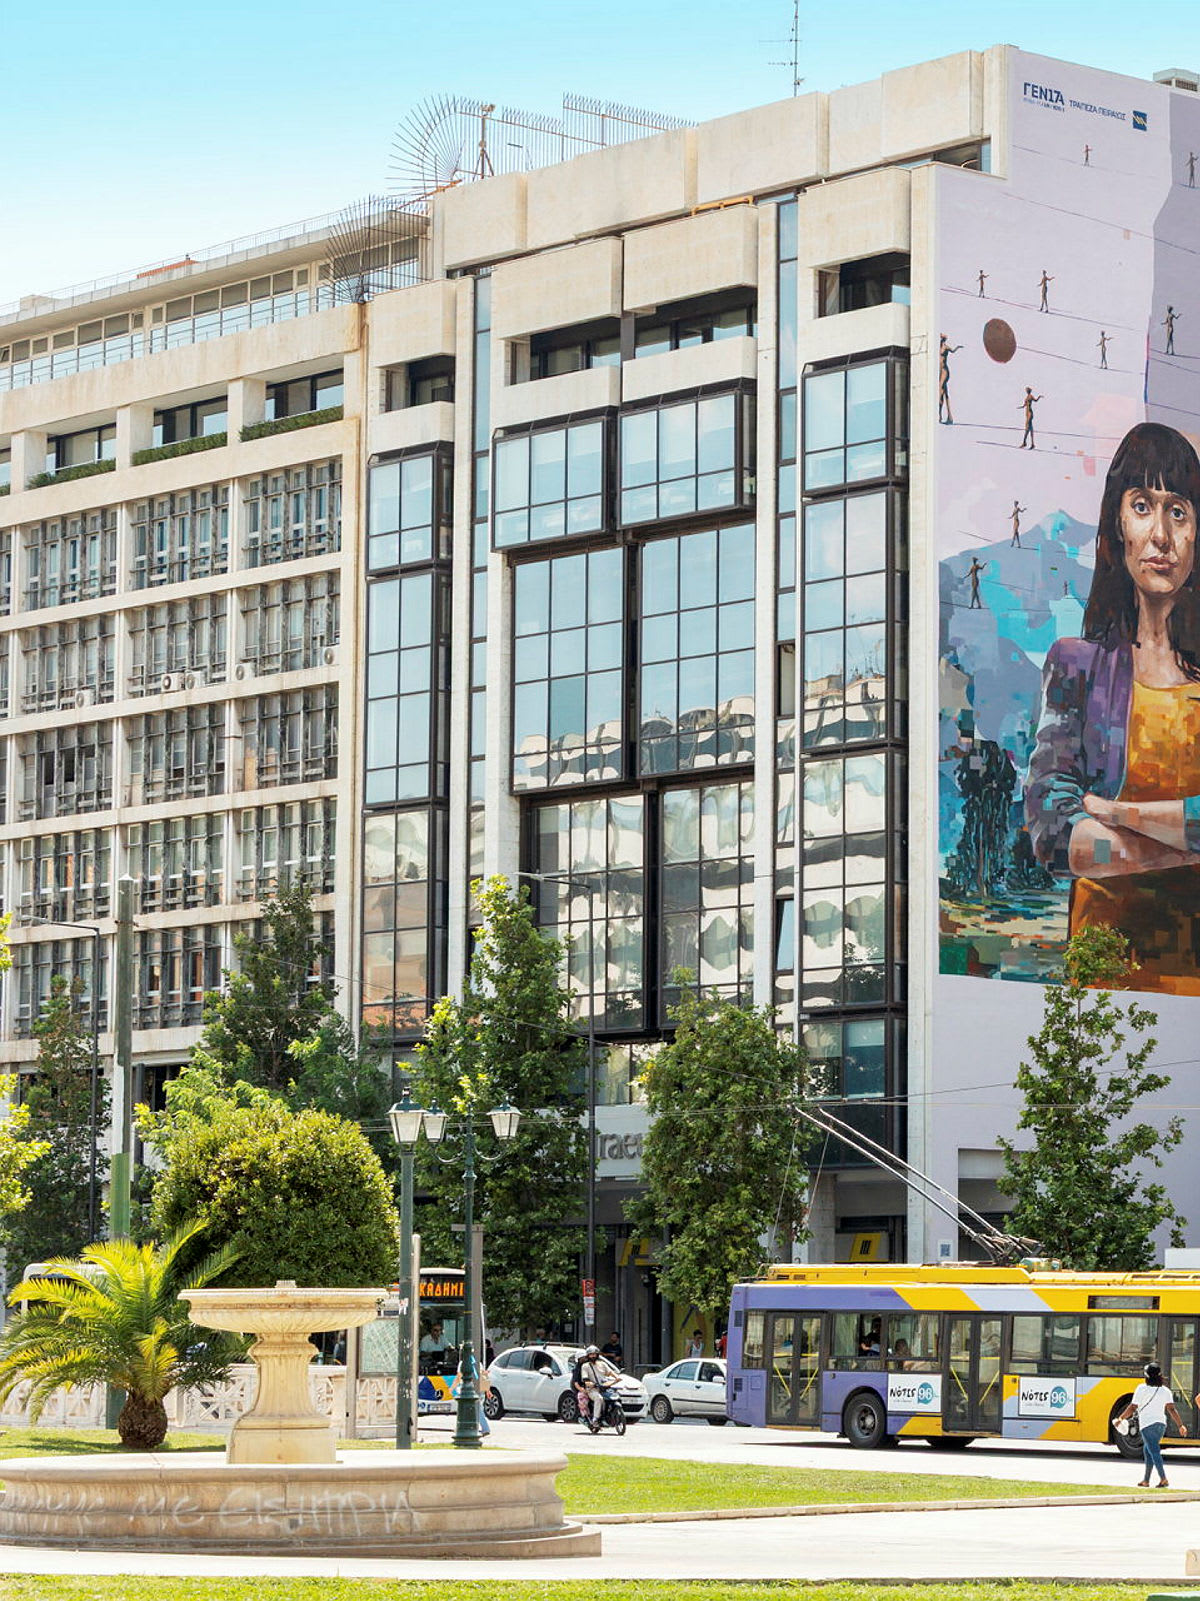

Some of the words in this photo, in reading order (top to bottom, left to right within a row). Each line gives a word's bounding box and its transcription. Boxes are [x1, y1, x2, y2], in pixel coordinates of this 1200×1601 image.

[420, 1282, 464, 1297] ΚΑΔΗΜΙ
[918, 1387, 933, 1401] 96
[1051, 1391, 1066, 1404] 96
